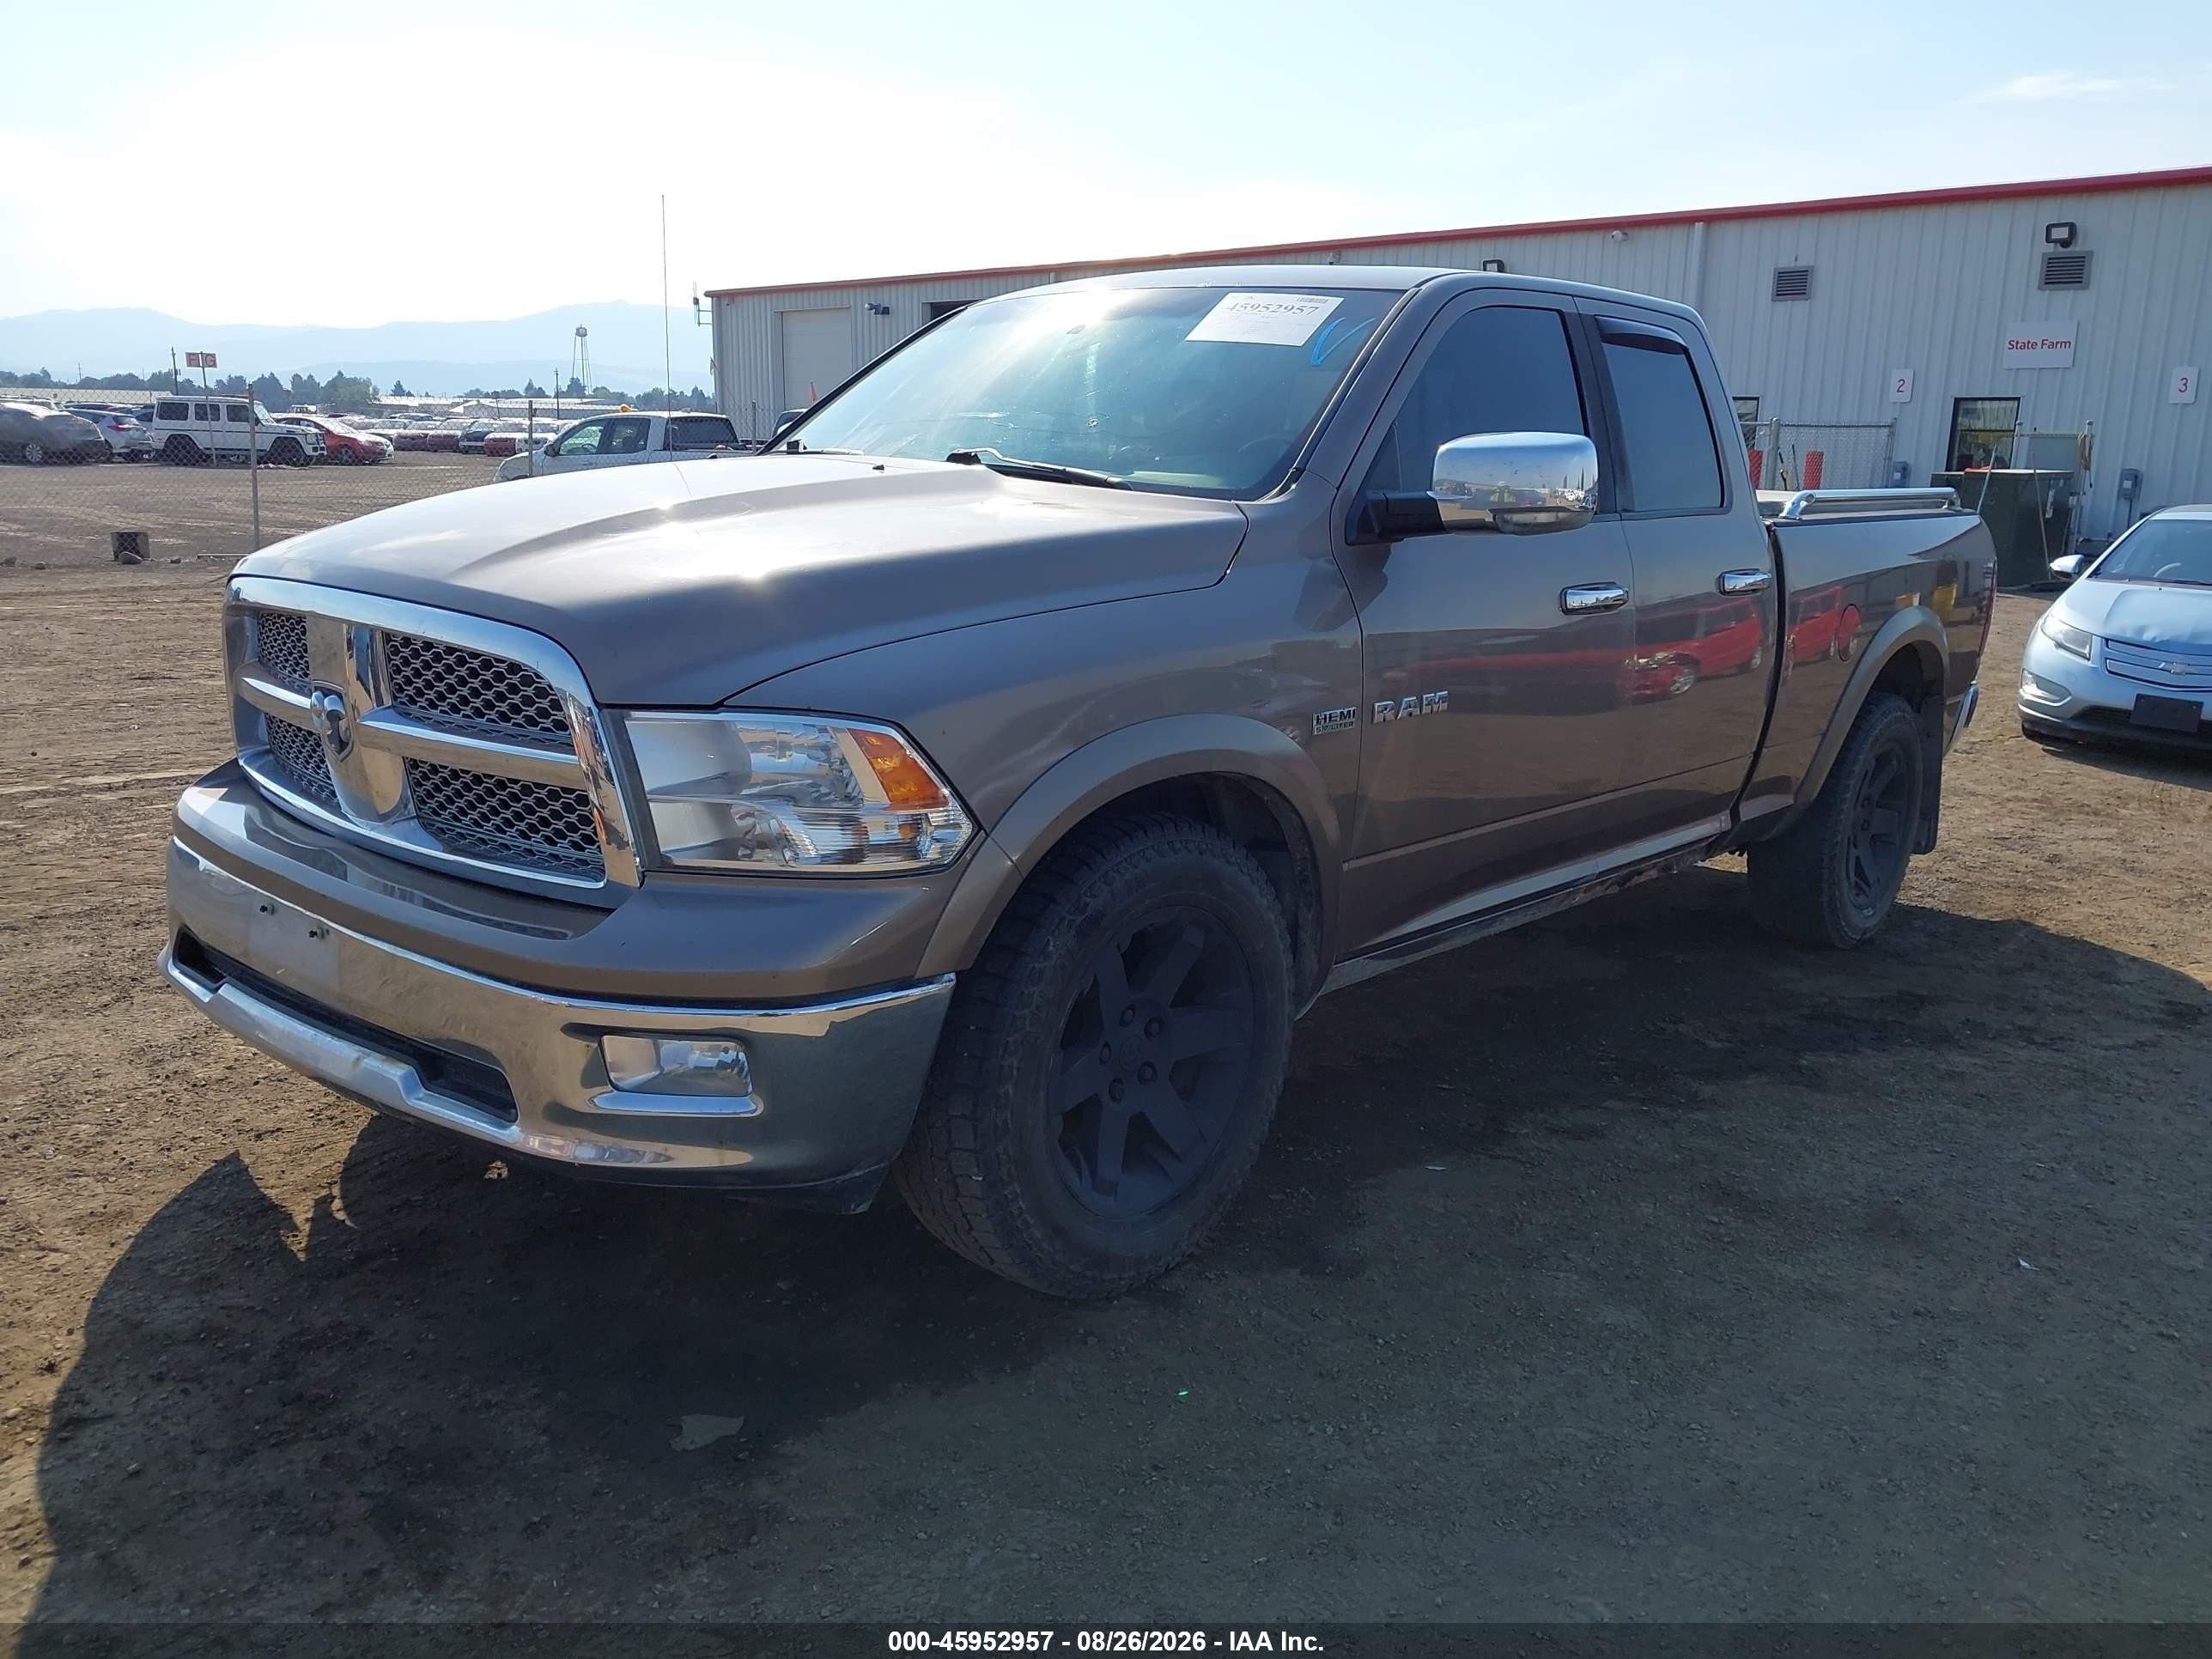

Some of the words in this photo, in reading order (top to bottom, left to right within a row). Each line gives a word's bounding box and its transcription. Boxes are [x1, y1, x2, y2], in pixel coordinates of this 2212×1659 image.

[1226, 302, 1320, 316] 45952957
[2008, 339, 2039, 349] State
[2040, 338, 2071, 349] Farm
[1896, 379, 1905, 393] 2
[2179, 377, 2188, 393] 3
[1372, 690, 1449, 724] RAM
[1315, 708, 1356, 726] HEMI
